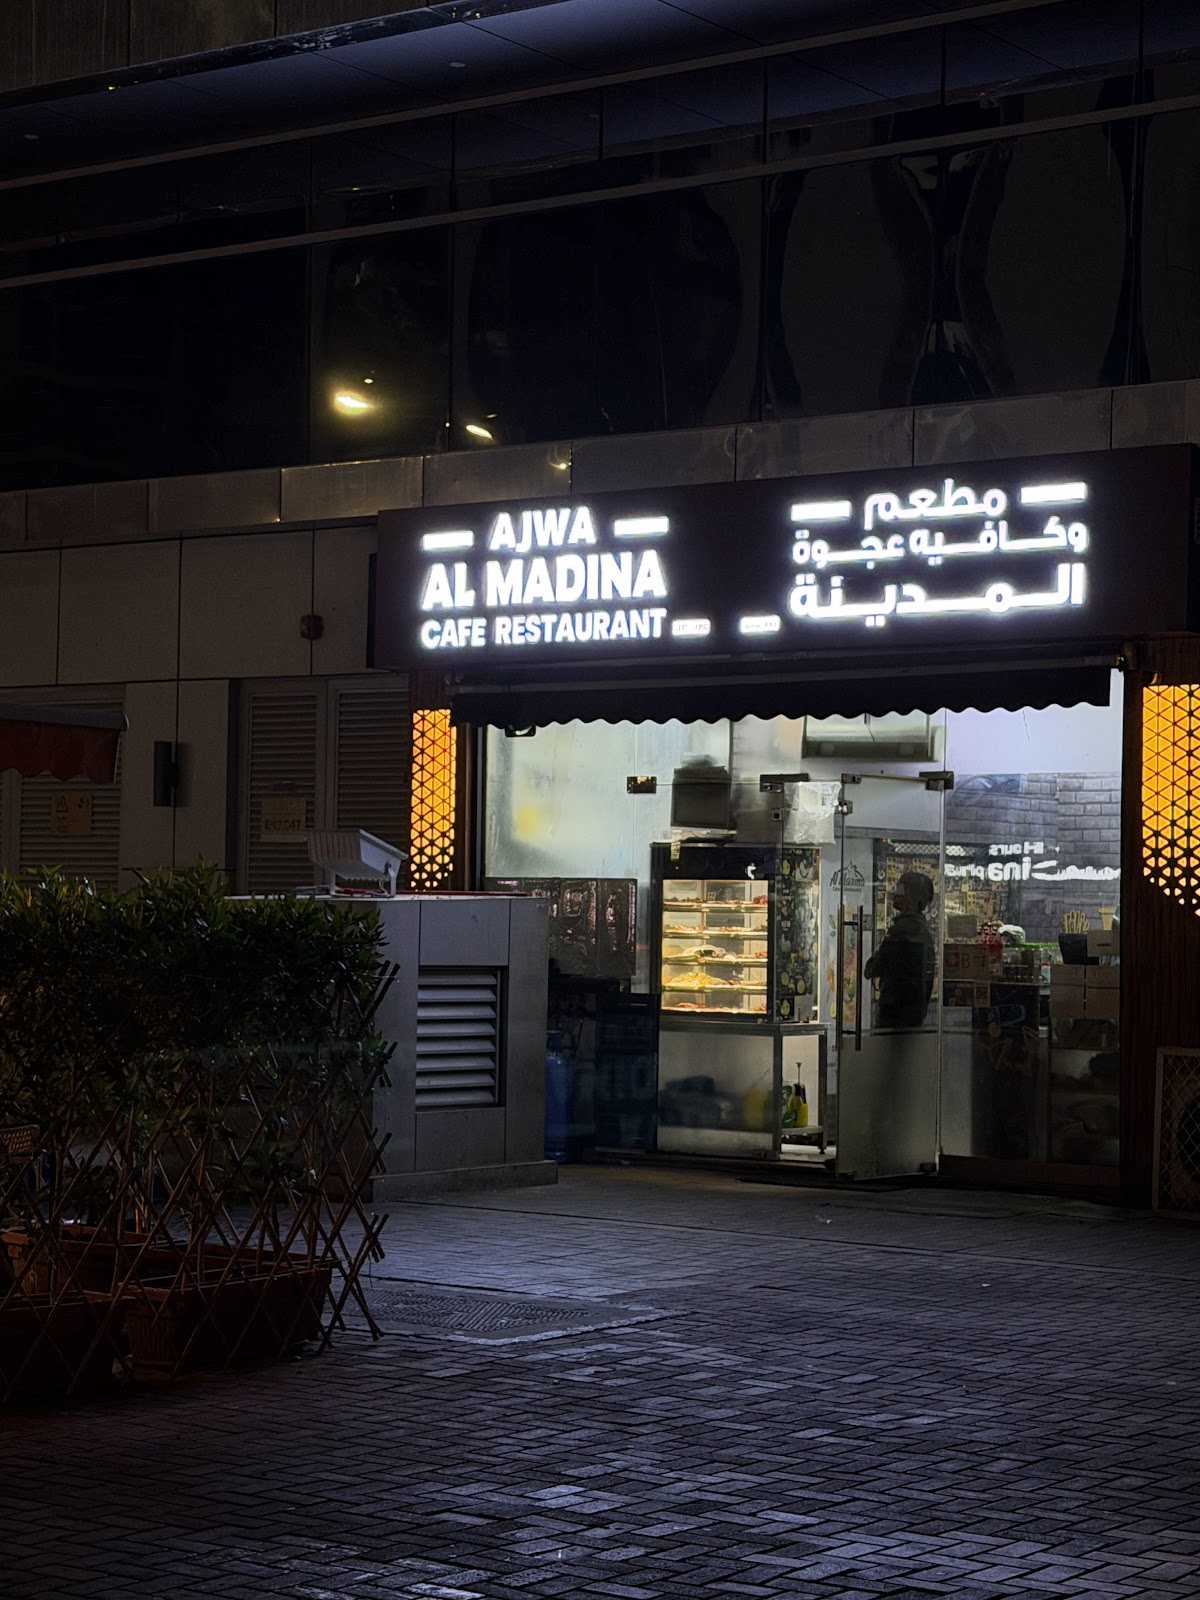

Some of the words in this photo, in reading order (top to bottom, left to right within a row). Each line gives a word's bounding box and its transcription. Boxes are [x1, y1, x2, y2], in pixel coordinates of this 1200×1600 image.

[488, 505, 597, 553] AJWA
[863, 478, 1007, 532] مطعم
[792, 530, 905, 570] عجوة
[420, 562, 476, 611] AL
[485, 549, 668, 607] MADINA
[789, 562, 1086, 627] المدينة
[420, 617, 487, 649] CAFE
[494, 607, 668, 645] RESTAURANT
